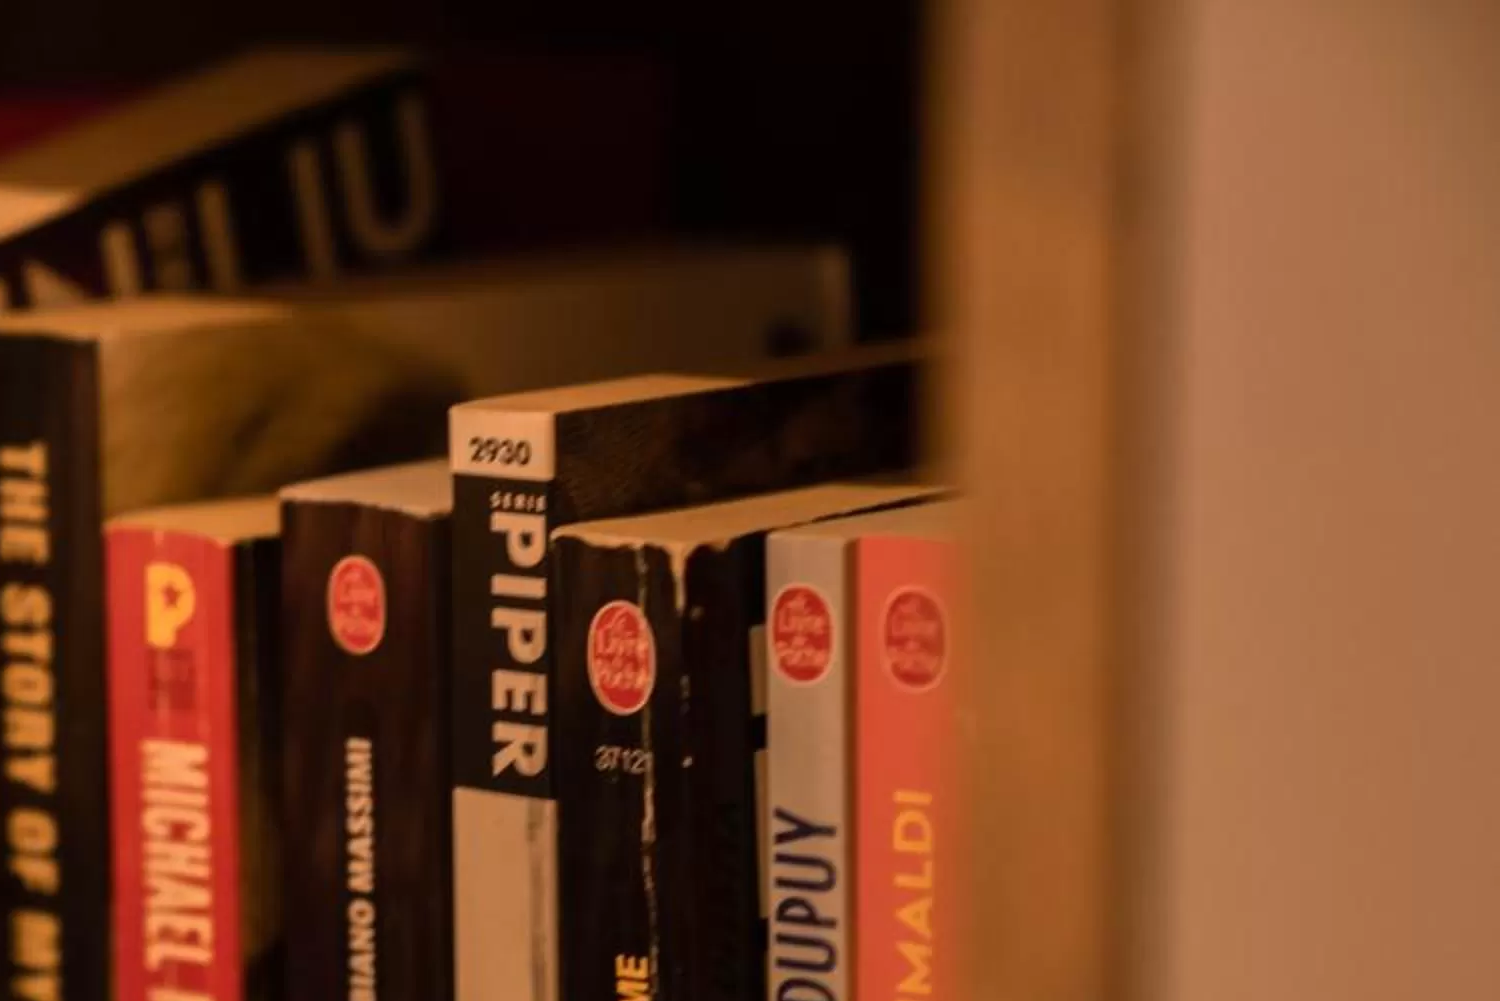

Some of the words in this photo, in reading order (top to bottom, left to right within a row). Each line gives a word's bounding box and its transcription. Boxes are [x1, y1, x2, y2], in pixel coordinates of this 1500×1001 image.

[468, 436, 533, 467] 2930
[489, 510, 549, 778] PIPER
[140, 739, 214, 971] MICHAEL
[345, 736, 373, 893] MASSIMI
